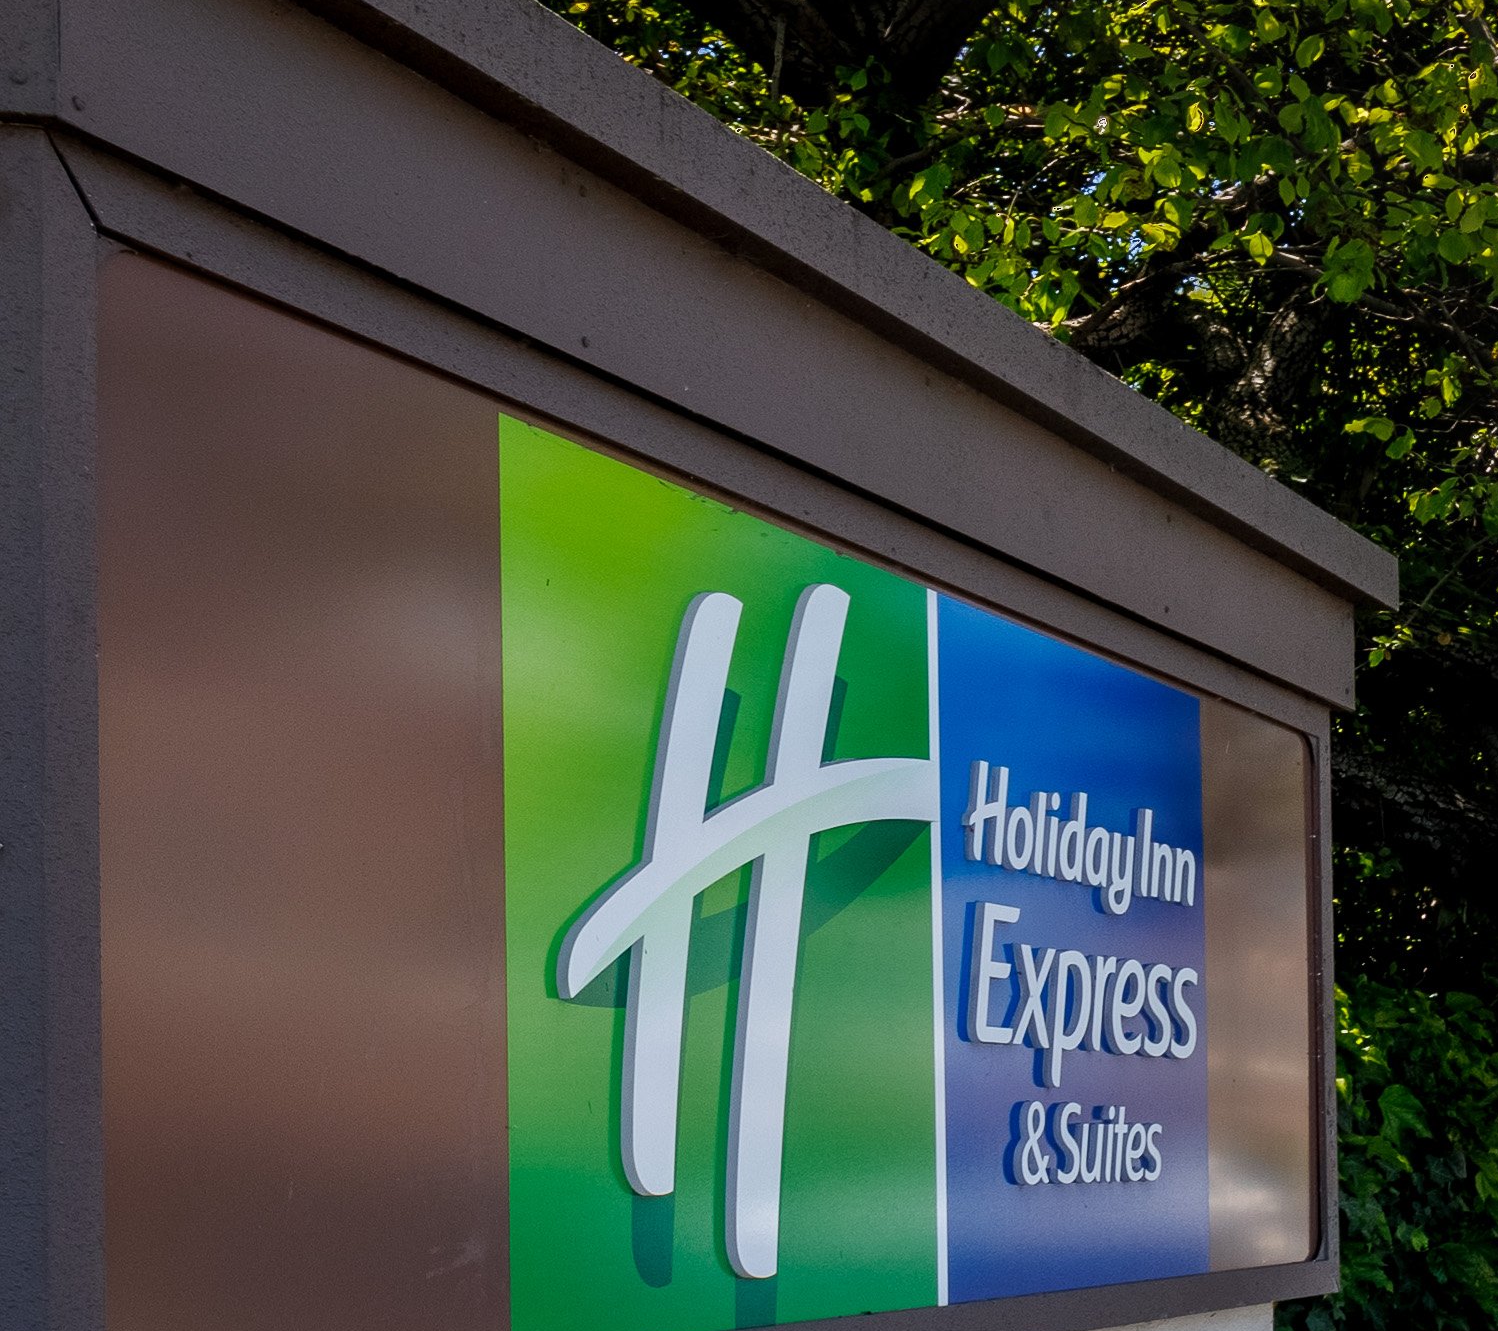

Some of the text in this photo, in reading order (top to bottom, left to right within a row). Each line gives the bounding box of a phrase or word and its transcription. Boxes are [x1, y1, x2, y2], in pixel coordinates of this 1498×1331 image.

[962, 760, 1196, 915] Holiday Inn
[970, 901, 1199, 1088] Express
[1016, 1101, 1163, 1185] & Suites
